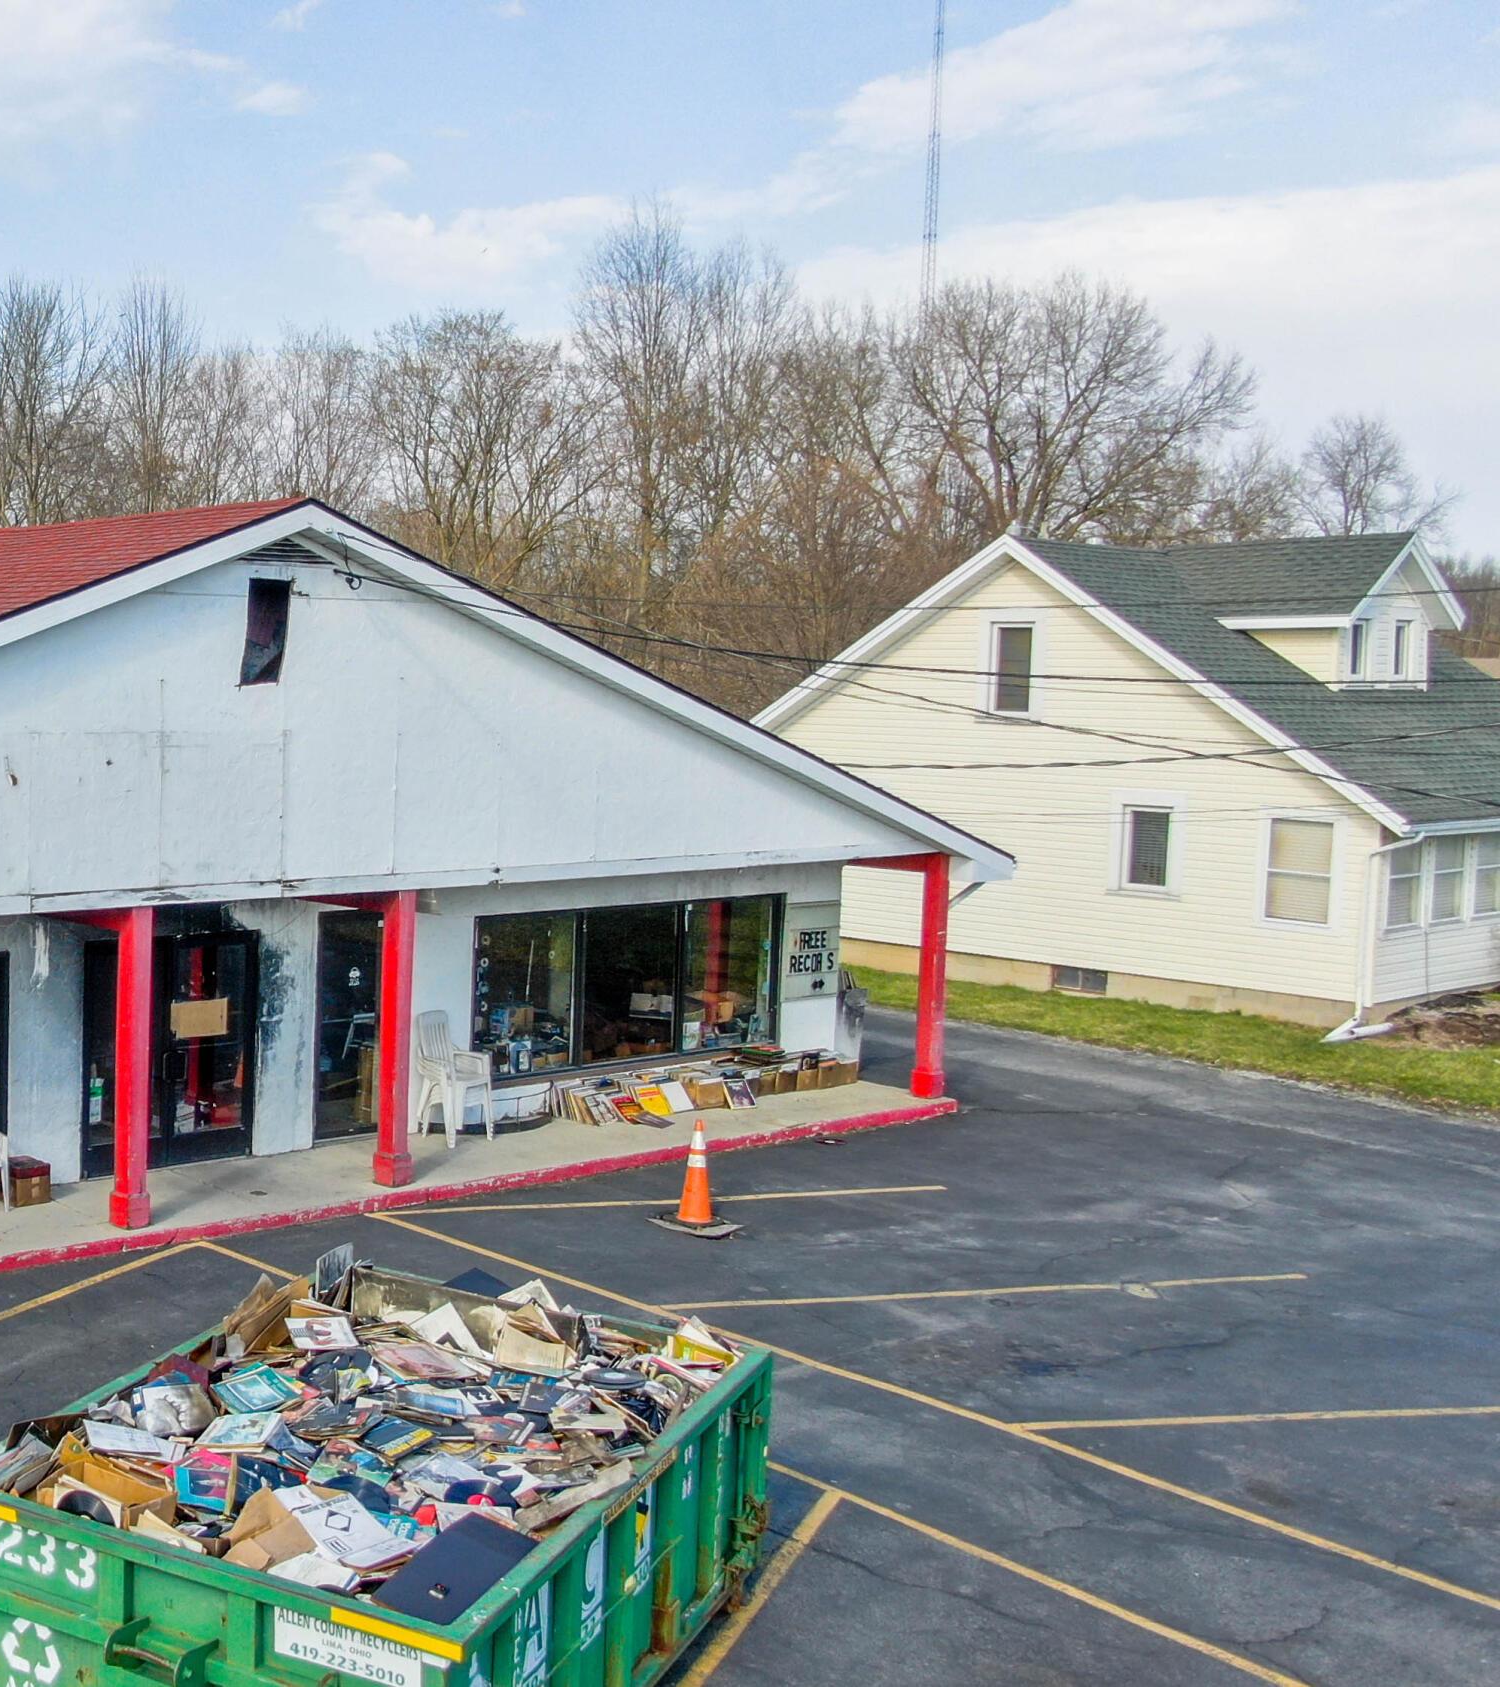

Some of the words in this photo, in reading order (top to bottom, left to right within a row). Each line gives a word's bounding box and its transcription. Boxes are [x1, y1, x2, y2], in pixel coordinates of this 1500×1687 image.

[277, 1607, 311, 1629] ALLEN
[313, 1616, 356, 1643] COUNTY
[289, 1641, 406, 1686] 419-223-5010
[349, 1646, 373, 1659] OHIO
